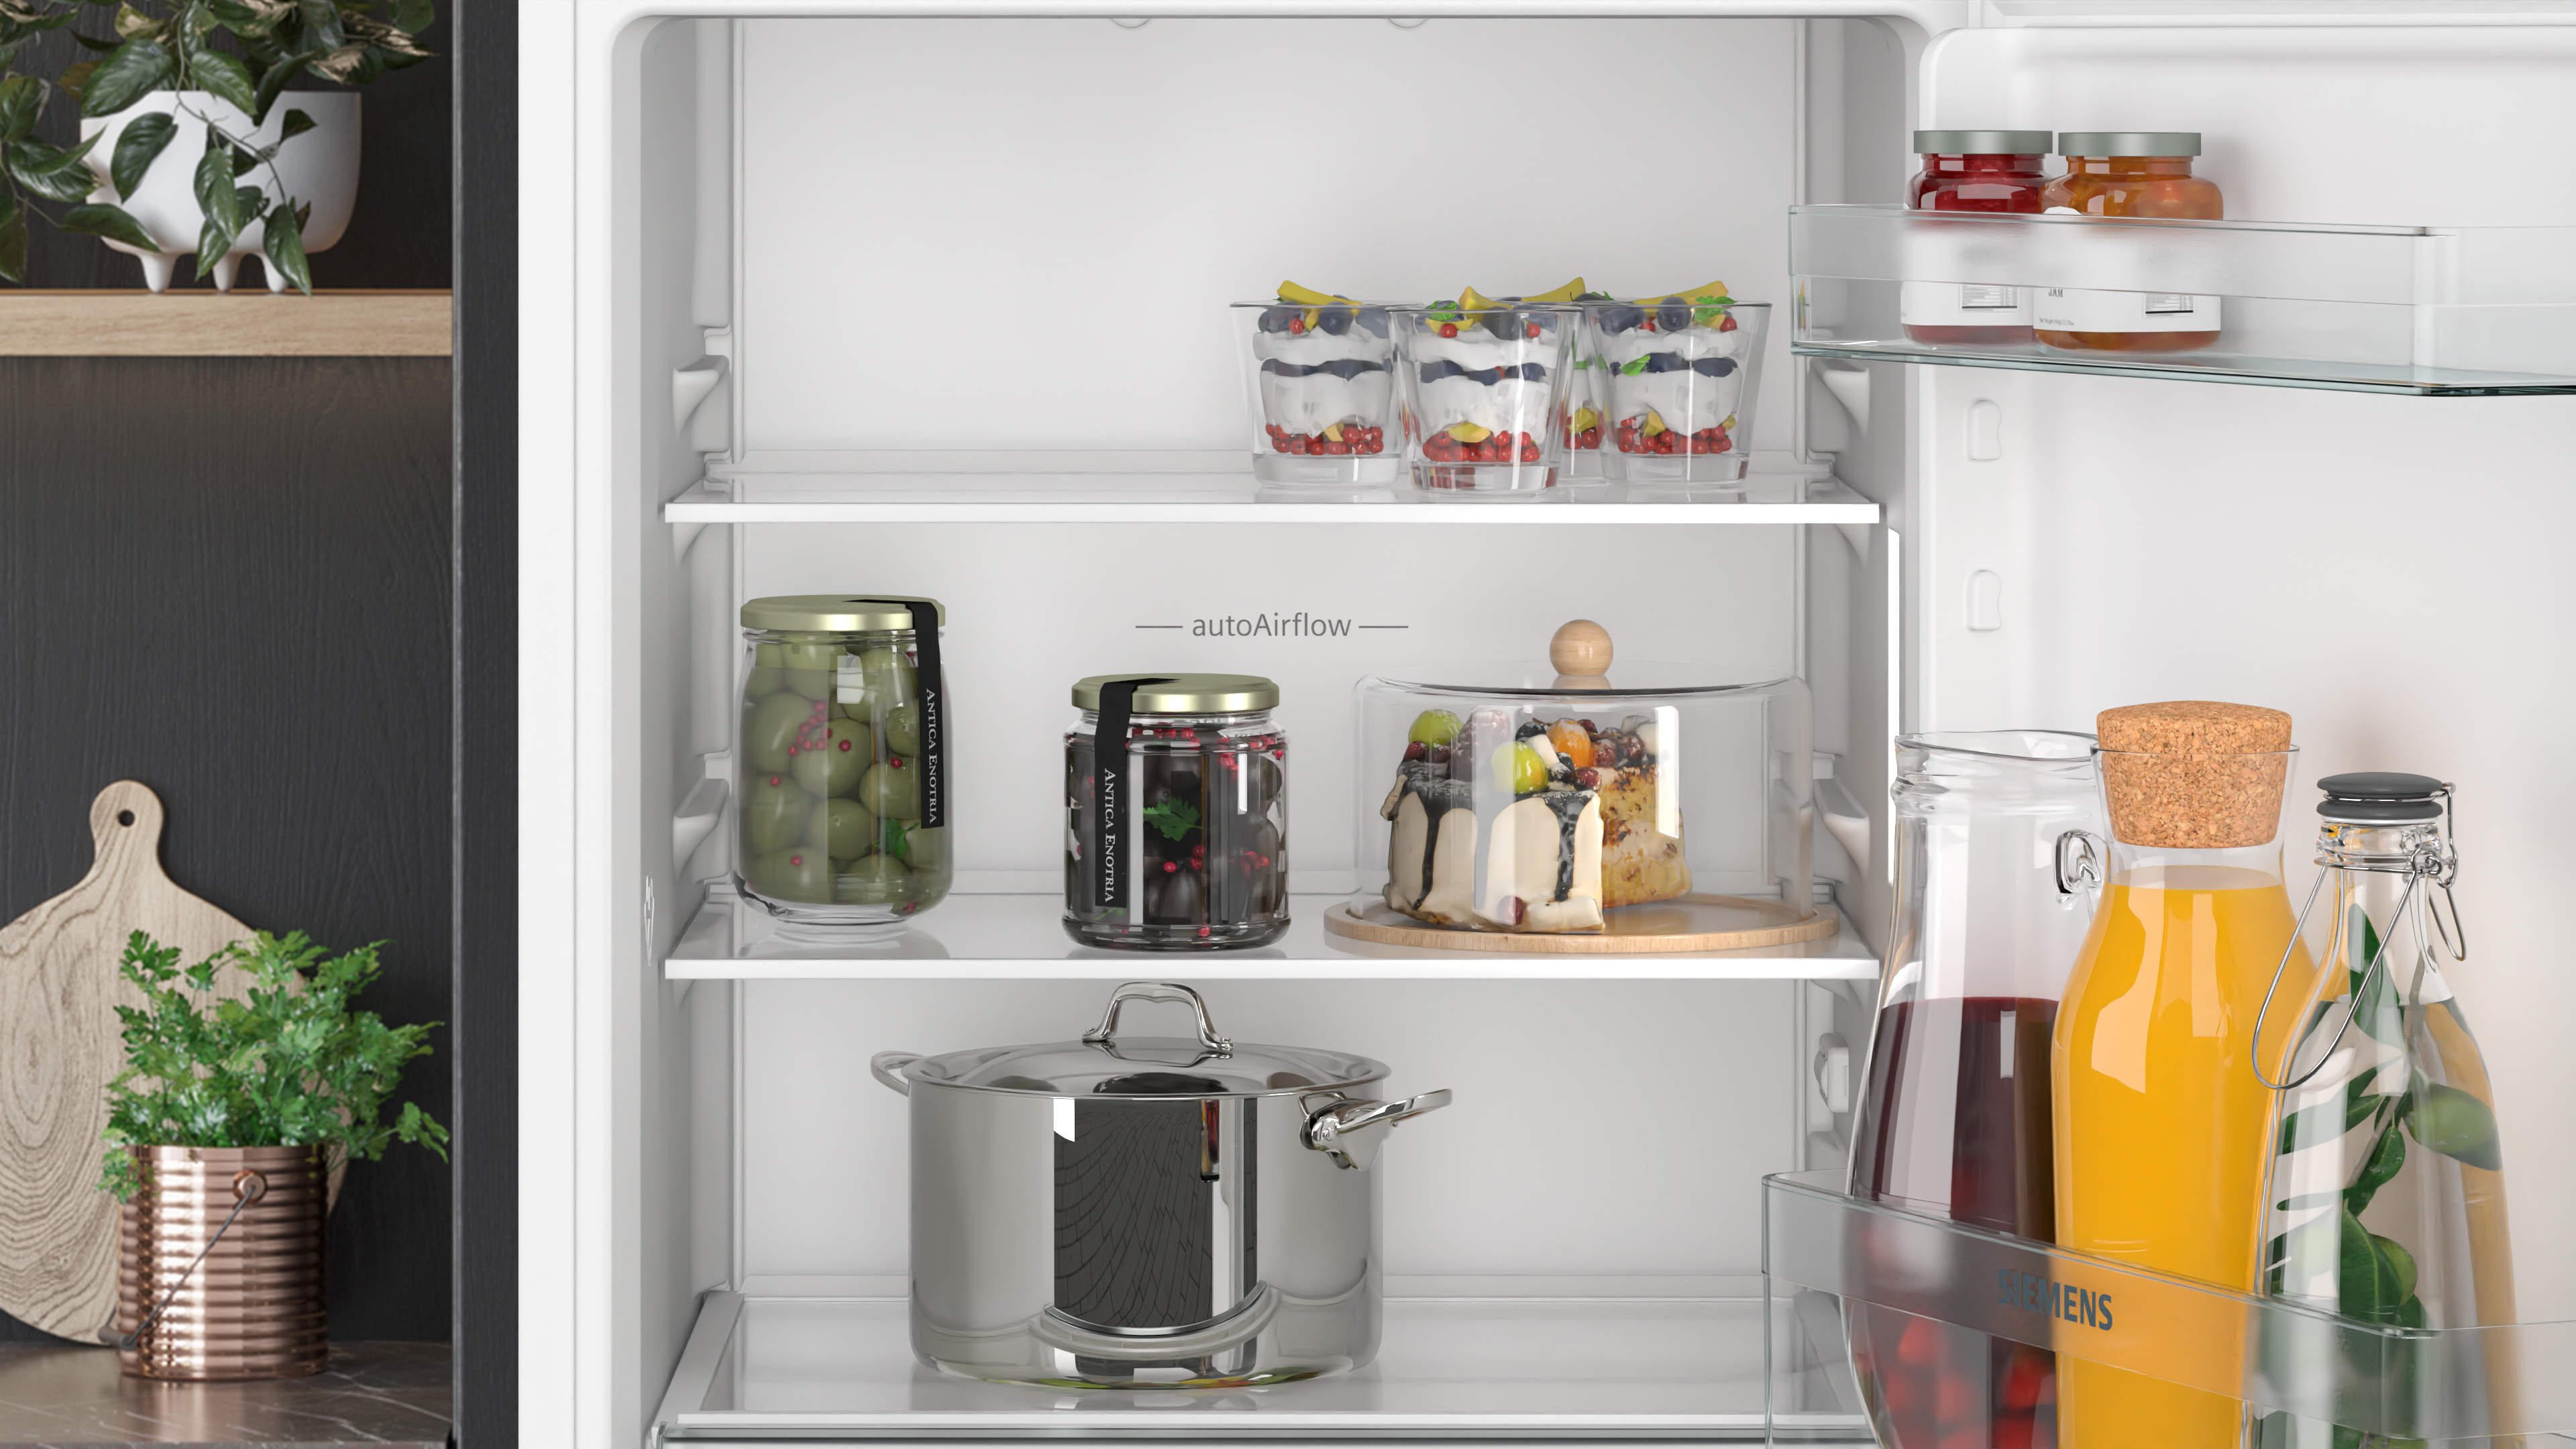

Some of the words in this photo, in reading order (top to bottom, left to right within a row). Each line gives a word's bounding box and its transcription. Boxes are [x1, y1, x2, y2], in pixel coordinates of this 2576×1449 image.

[2048, 288, 2063, 298] JAM
[1192, 612, 1352, 637] autoAirflow
[926, 688, 936, 750] ANTICA
[928, 753, 938, 824] ENOTRIA
[1104, 767, 1116, 830] ANTICA
[1104, 833, 1116, 903] ENOTRIA
[1998, 1269, 2113, 1331] SIEMENS
